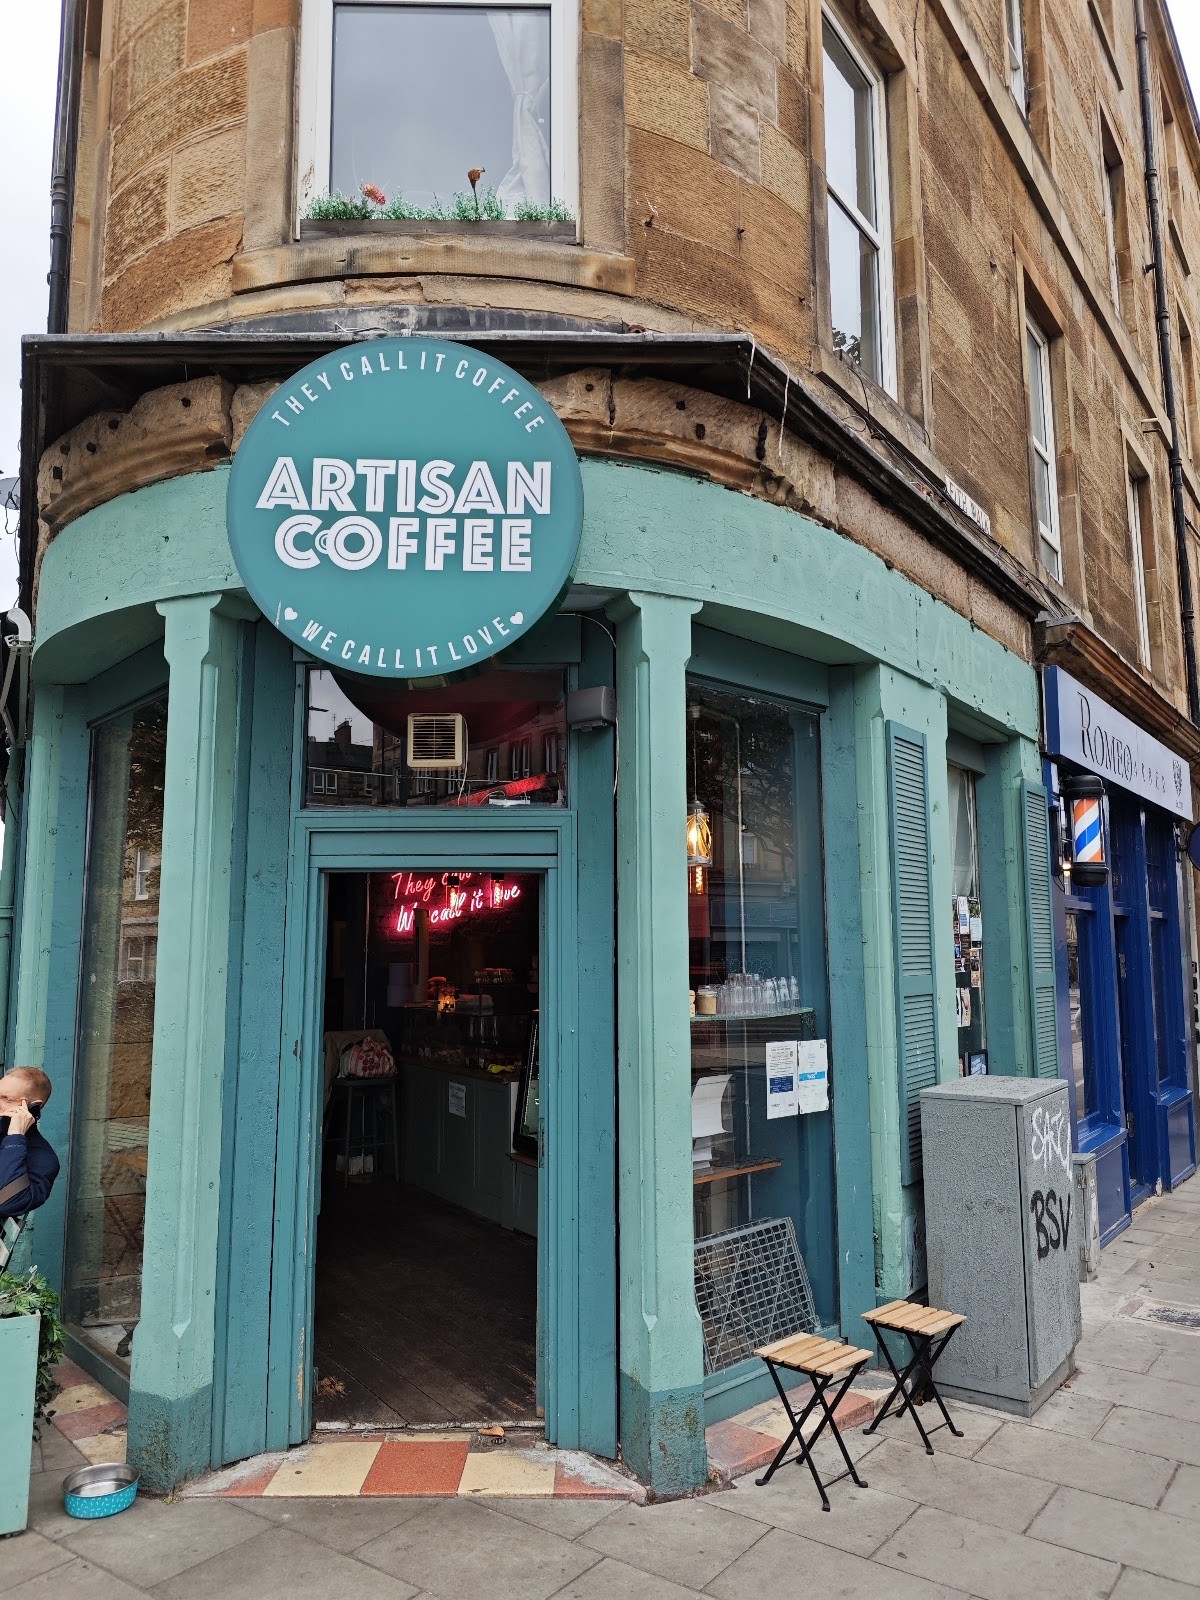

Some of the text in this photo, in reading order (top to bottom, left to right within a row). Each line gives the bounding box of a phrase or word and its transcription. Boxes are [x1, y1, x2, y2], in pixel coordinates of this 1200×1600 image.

[271, 350, 545, 433] THEY CALL IT COFFEE
[255, 456, 552, 515] ARTISAN
[274, 514, 532, 572] COFFEE
[301, 616, 510, 669] WE CALL IT LOVE
[391, 872, 437, 902] They
[470, 888, 484, 912] it
[1030, 1189, 1071, 1261] BSV
